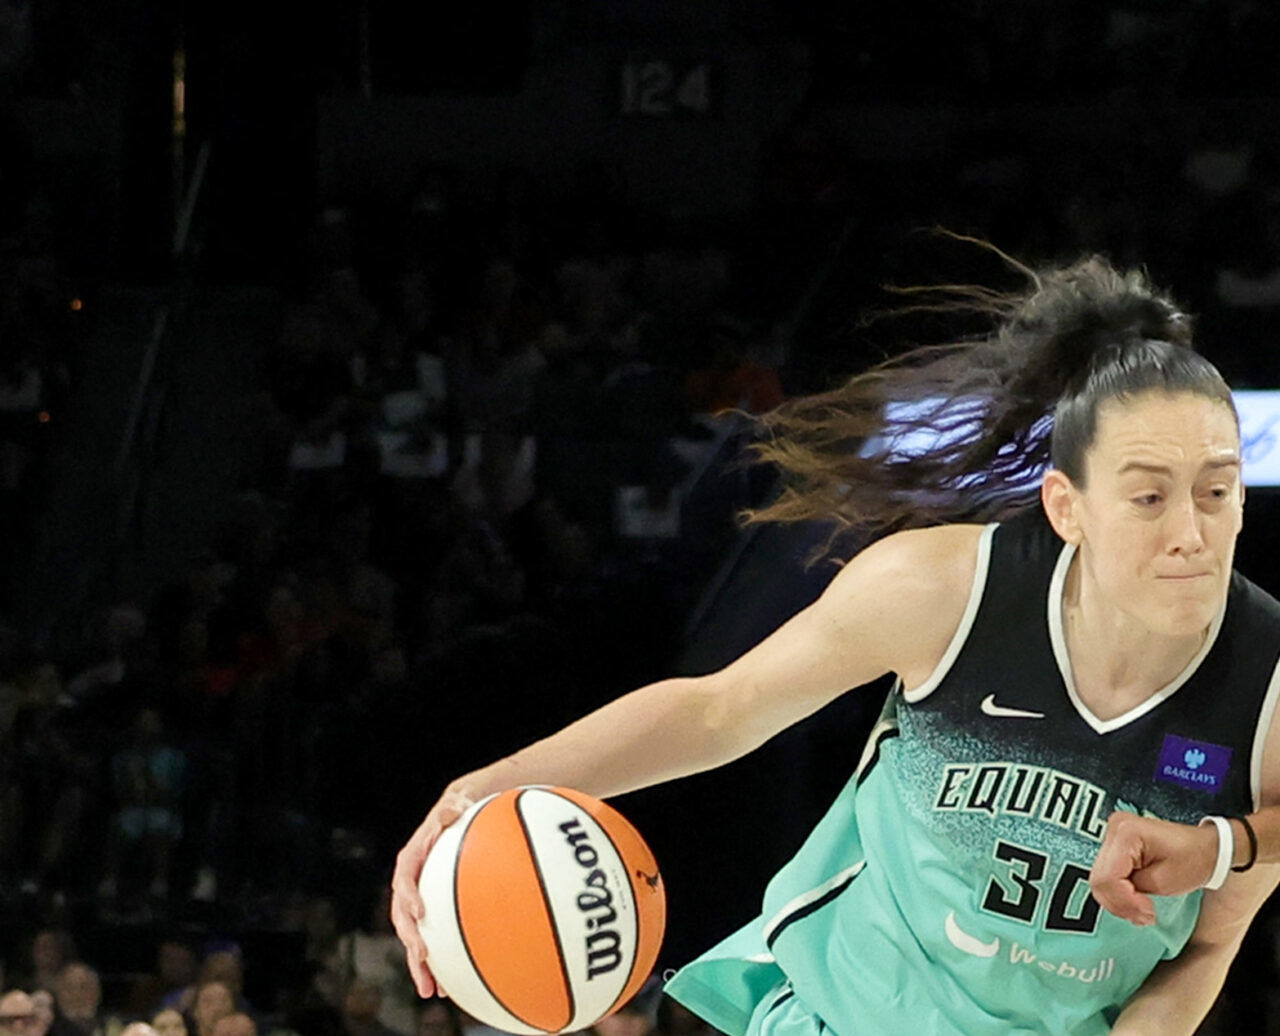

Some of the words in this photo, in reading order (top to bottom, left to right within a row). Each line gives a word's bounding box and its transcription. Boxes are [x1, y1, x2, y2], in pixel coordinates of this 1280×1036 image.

[621, 62, 711, 114] 124
[932, 761, 1109, 843] EQUAL
[1163, 765, 1217, 786] BARCLAYS
[558, 815, 623, 982] Wilson
[980, 838, 1104, 936] 30
[1009, 941, 1115, 983] Webull
